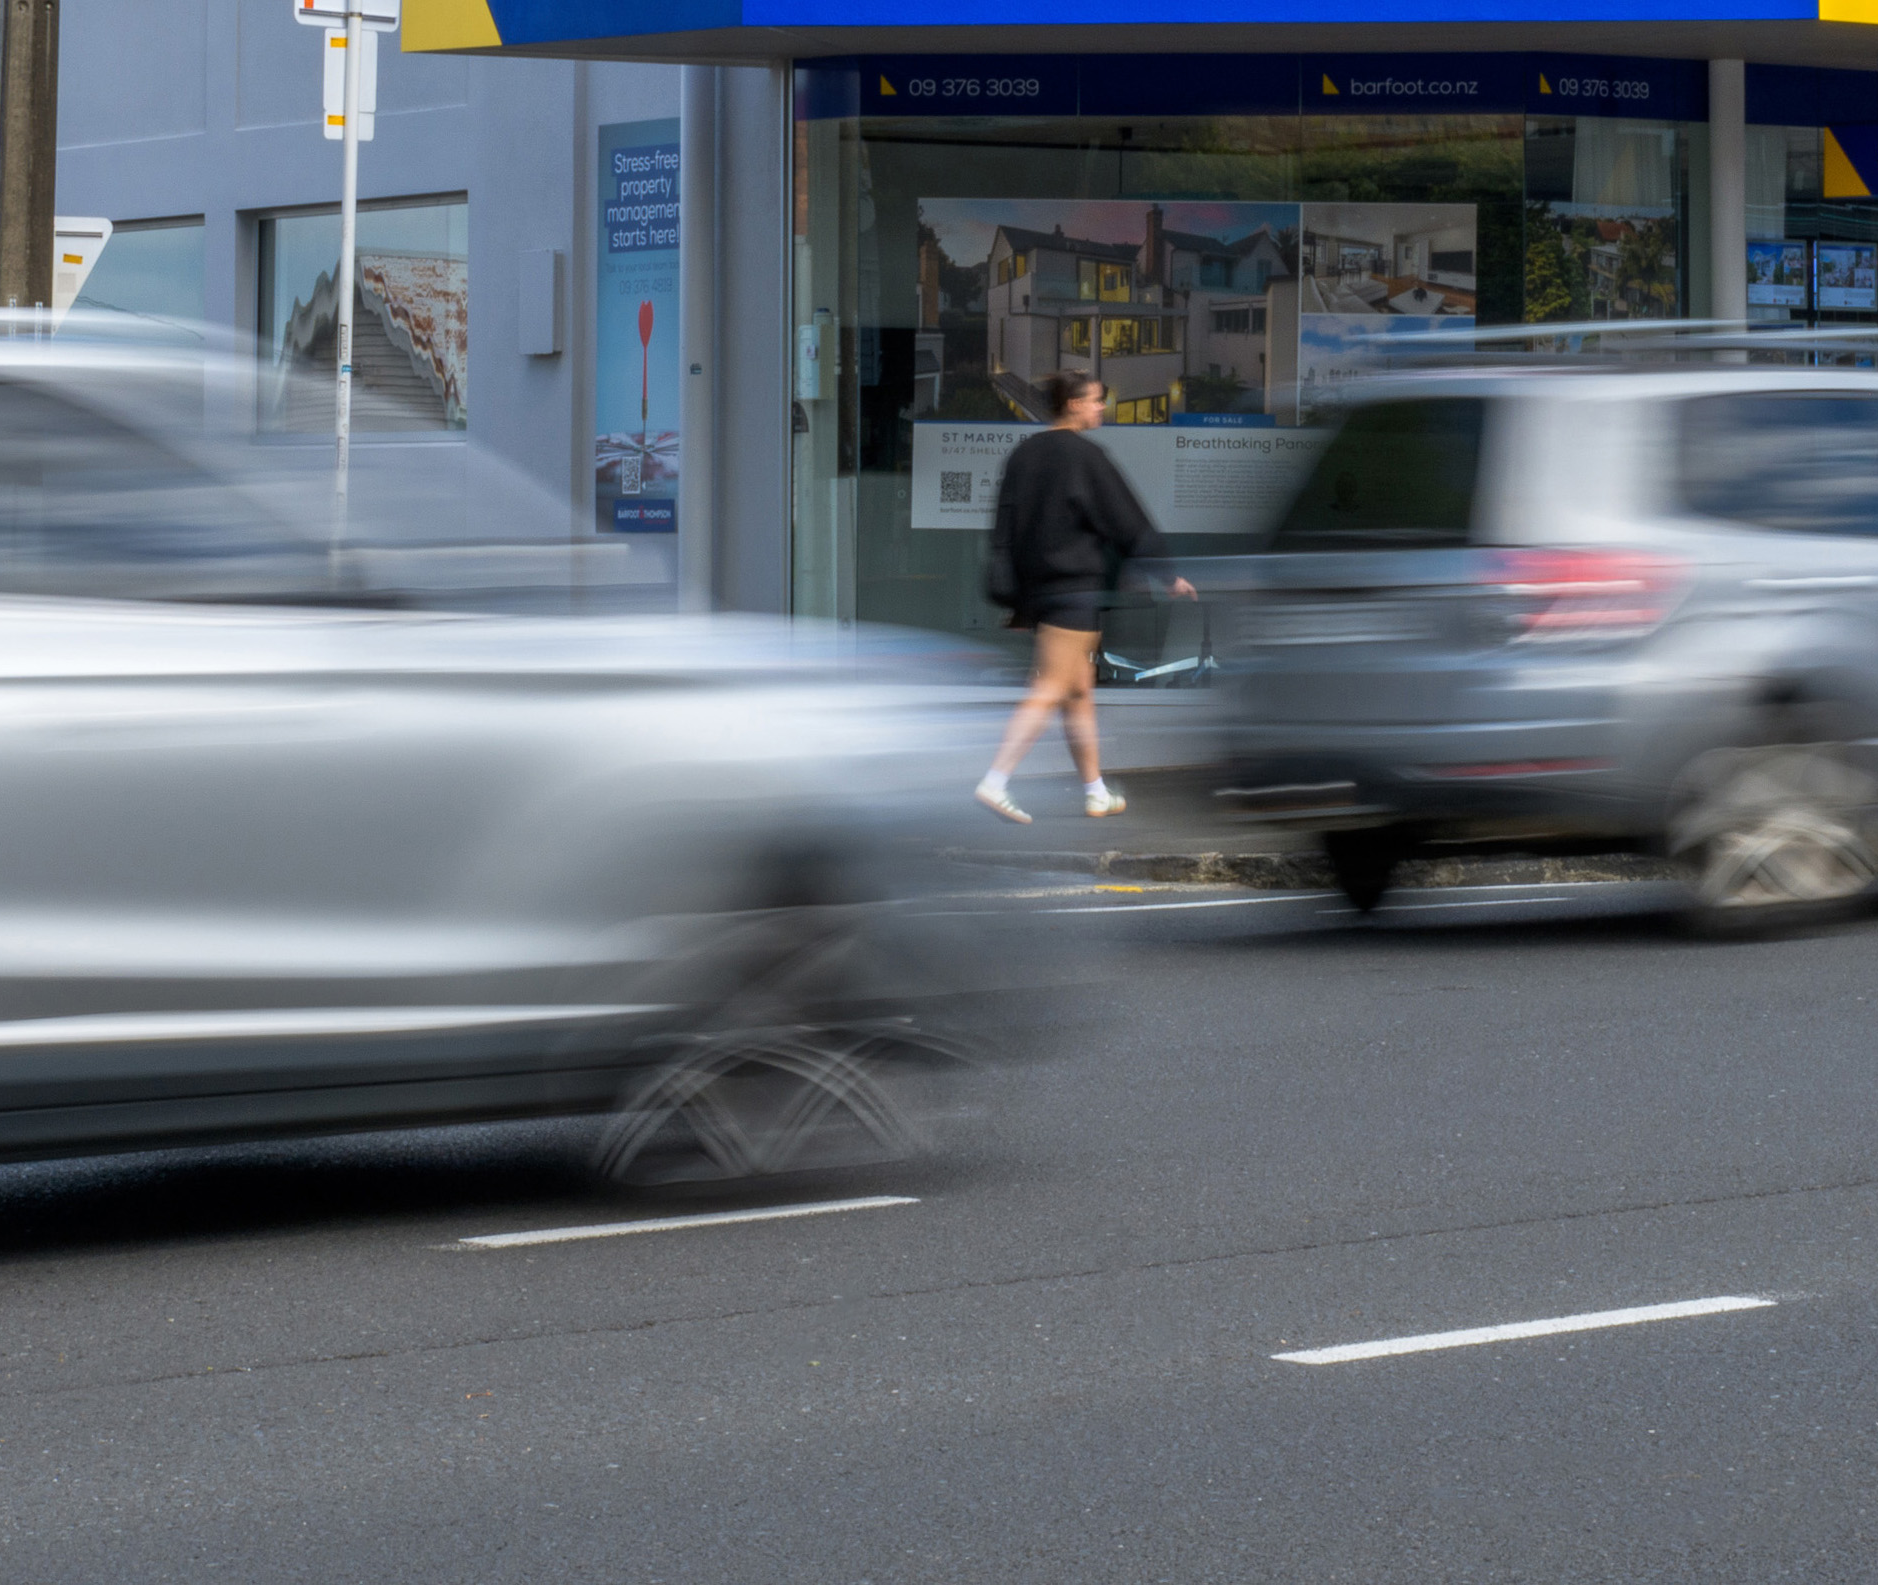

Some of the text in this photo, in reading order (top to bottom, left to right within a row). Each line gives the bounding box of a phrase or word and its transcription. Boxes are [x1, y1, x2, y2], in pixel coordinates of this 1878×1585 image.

[909, 78, 1039, 96] 09 376 3039
[1350, 76, 1479, 96] barfoot.co.nz
[1559, 78, 1649, 99] 09 376 3039
[614, 149, 679, 174] Stress-free
[620, 176, 672, 202] property
[607, 201, 680, 227] managemen
[612, 224, 680, 248] starts here!
[1203, 416, 1243, 424] FOR SALE
[942, 432, 959, 443] ST
[964, 433, 1014, 444] MARYS
[1176, 436, 1271, 453] Breathtaking
